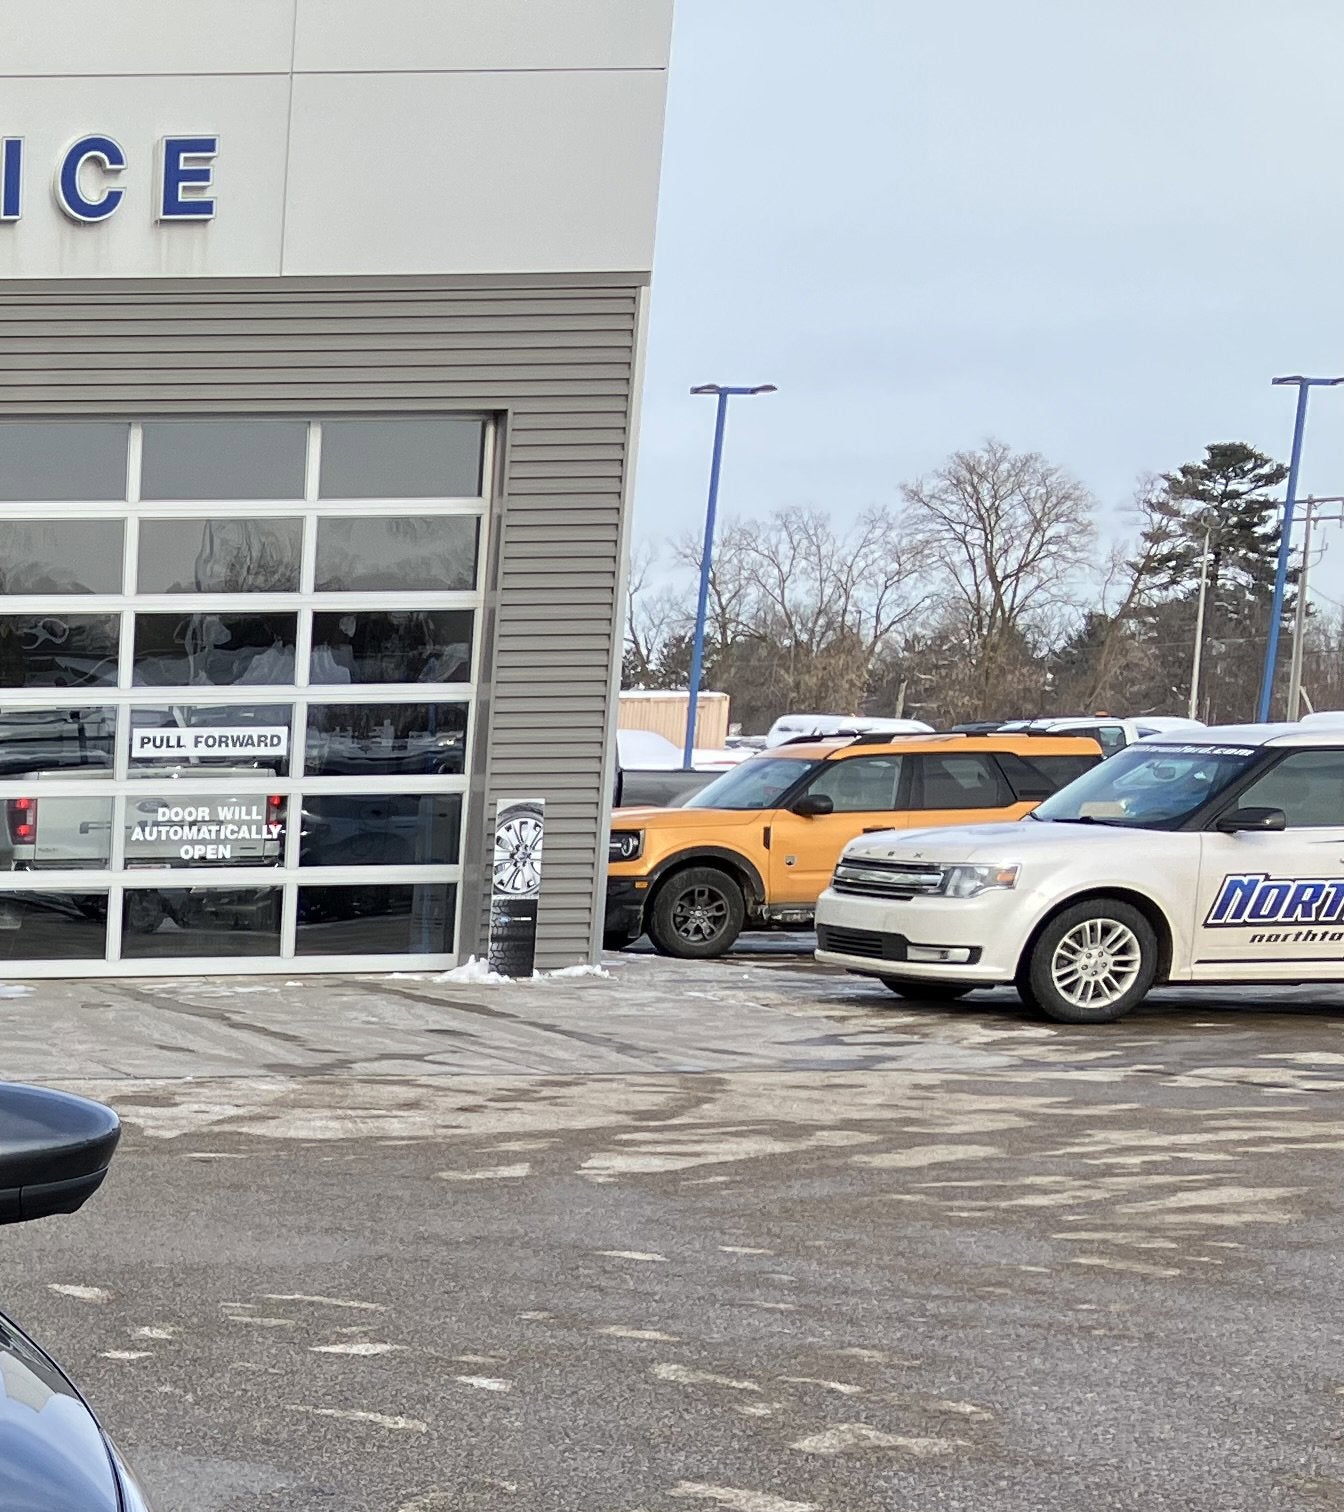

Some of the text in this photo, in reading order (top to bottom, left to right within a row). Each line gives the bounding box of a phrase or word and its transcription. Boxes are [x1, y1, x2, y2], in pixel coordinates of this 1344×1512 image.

[139, 732, 282, 750] PULL FORWARD
[157, 806, 262, 821] DOOR WILL
[131, 824, 283, 841] AUTOMATICALLY
[180, 844, 231, 860] OPEN
